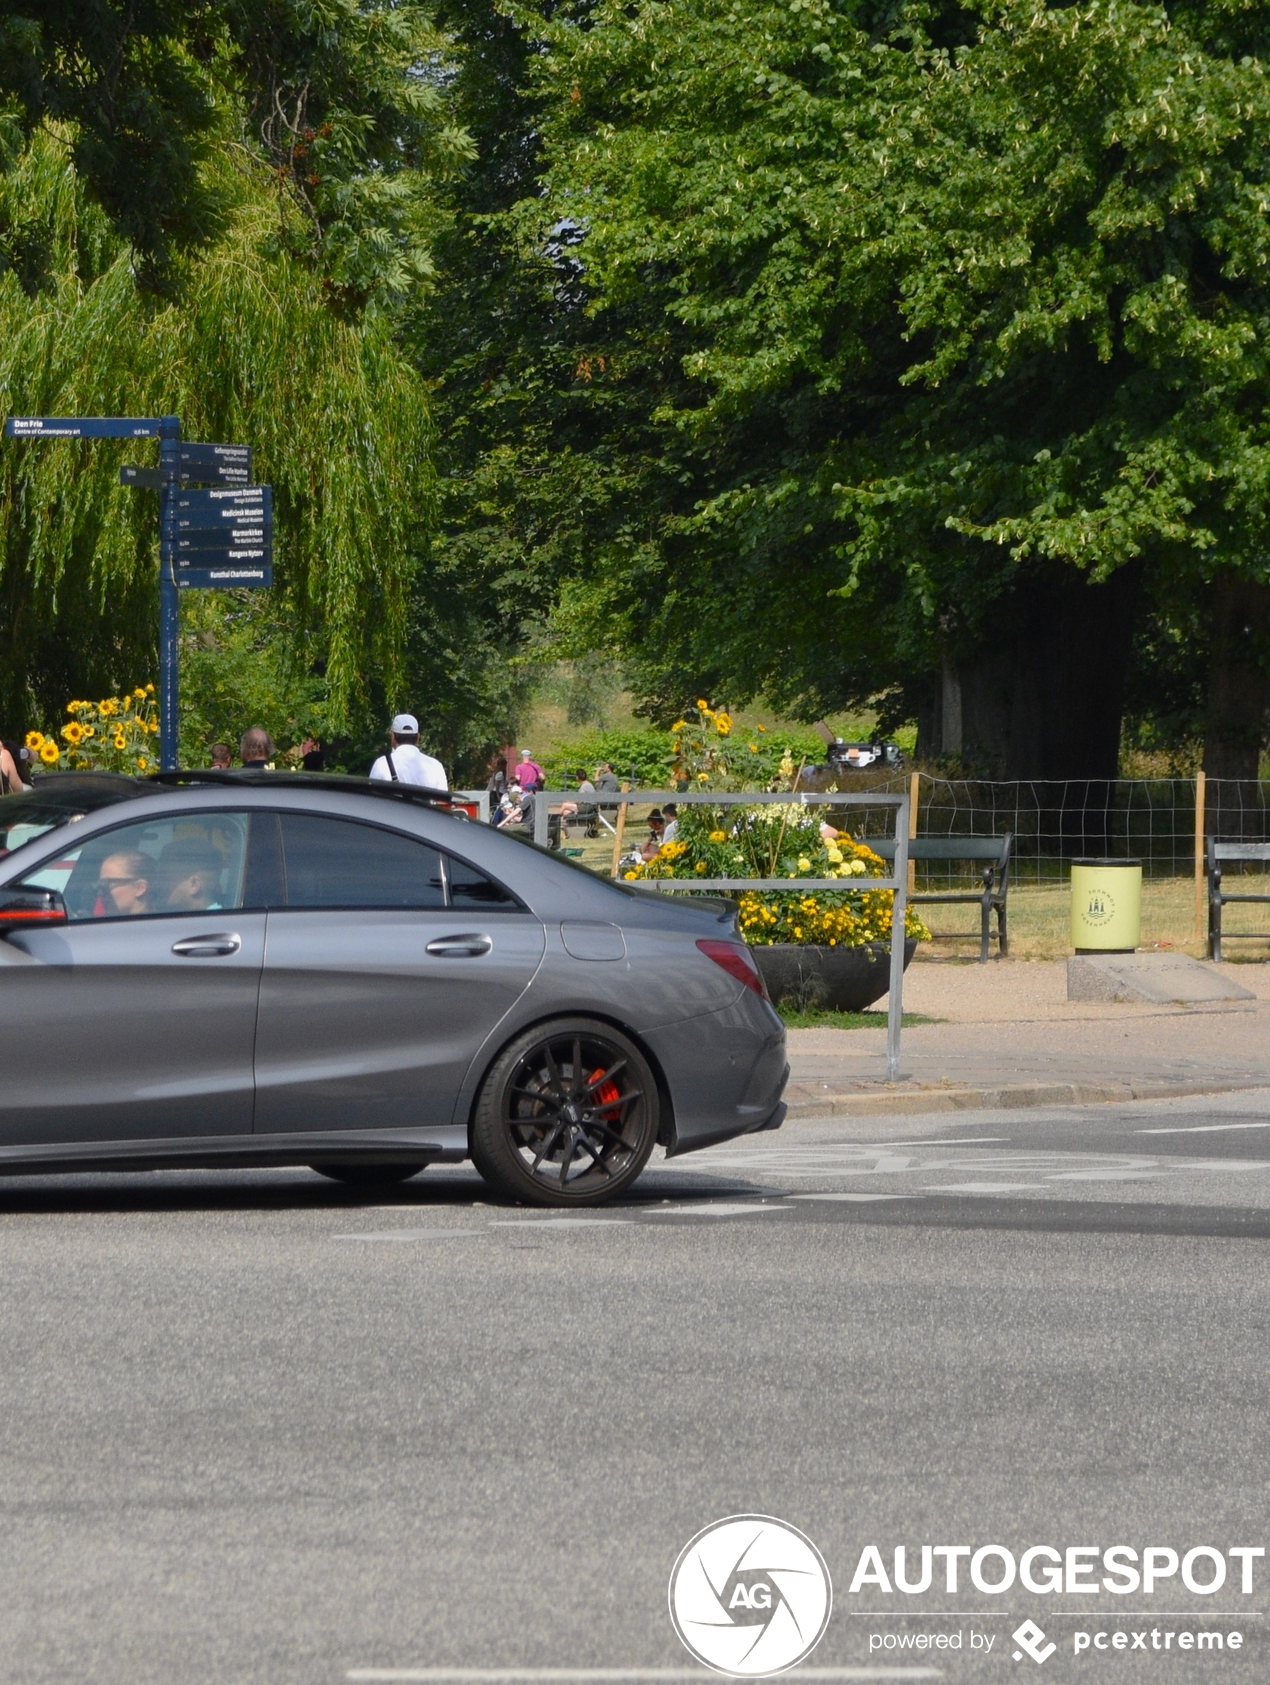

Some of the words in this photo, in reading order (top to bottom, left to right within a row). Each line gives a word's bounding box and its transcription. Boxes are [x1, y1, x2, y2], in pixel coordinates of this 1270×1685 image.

[210, 490, 242, 499] Designmuseum
[229, 550, 247, 559] Kongens
[248, 550, 264, 558] Nytorv
[231, 570, 263, 578] Charlottenborg
